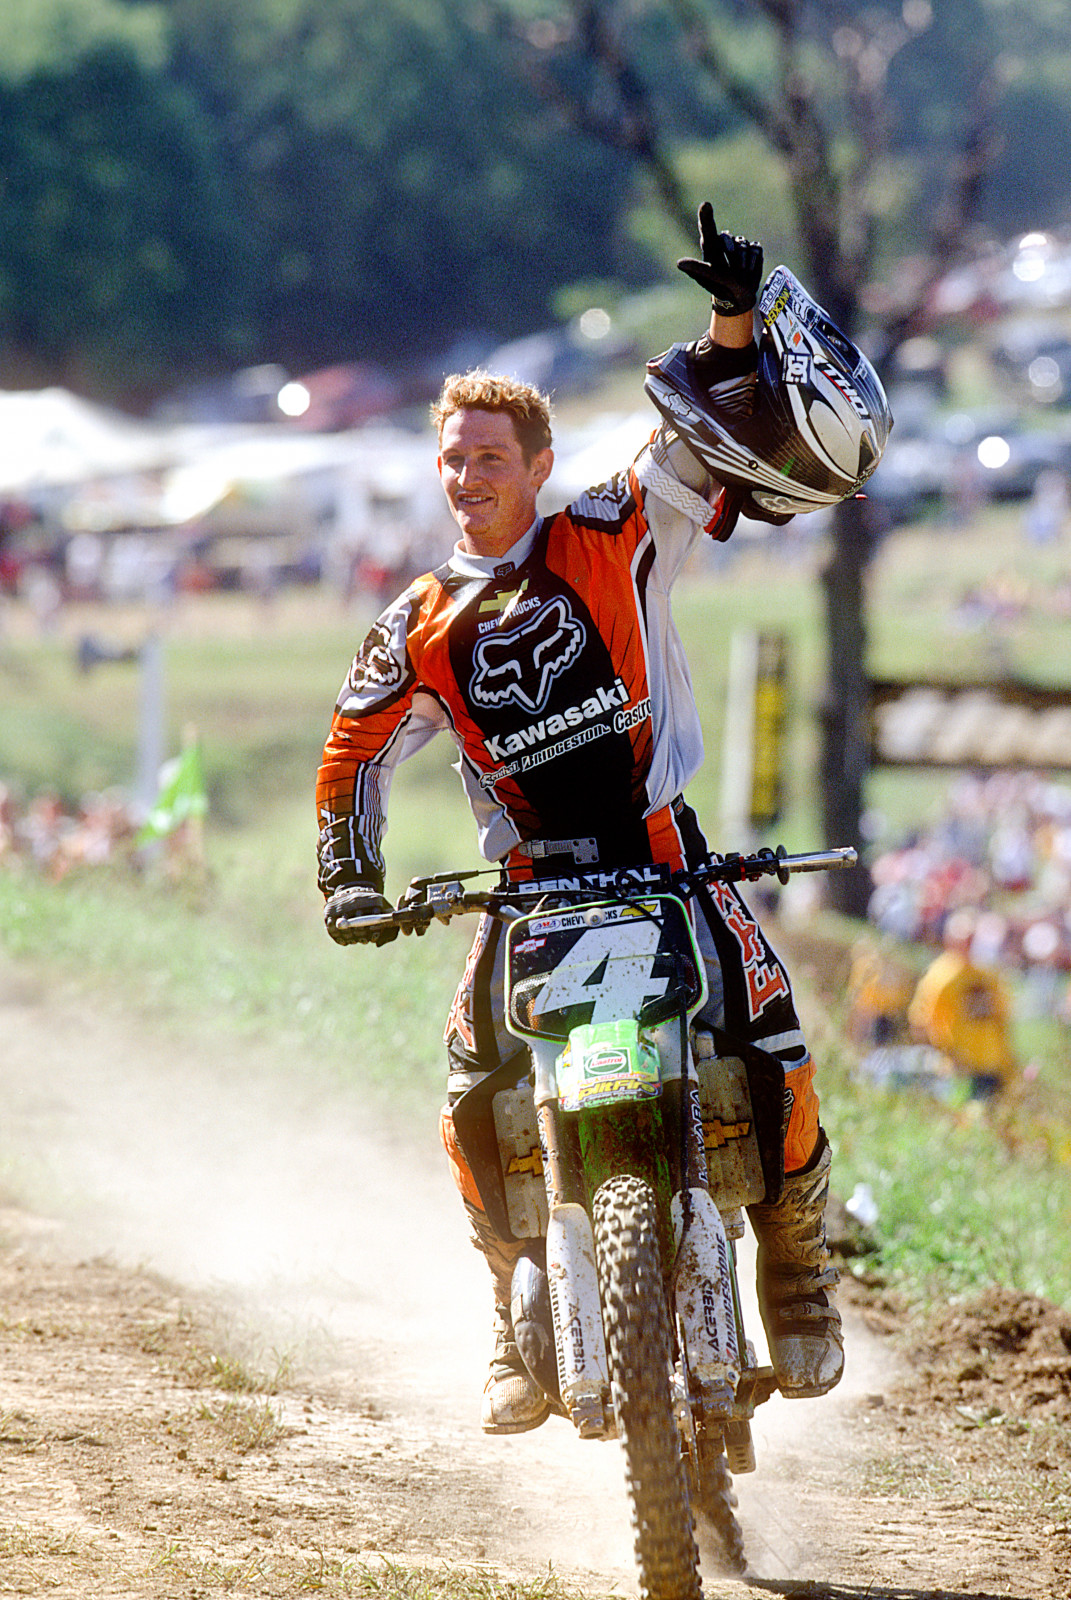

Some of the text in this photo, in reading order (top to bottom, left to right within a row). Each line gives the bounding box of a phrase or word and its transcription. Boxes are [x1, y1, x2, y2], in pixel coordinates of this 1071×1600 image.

[478, 617, 503, 634] CHEV
[483, 678, 630, 762] Kawasaki
[614, 696, 652, 734] Castro
[532, 921, 671, 1025] 4
